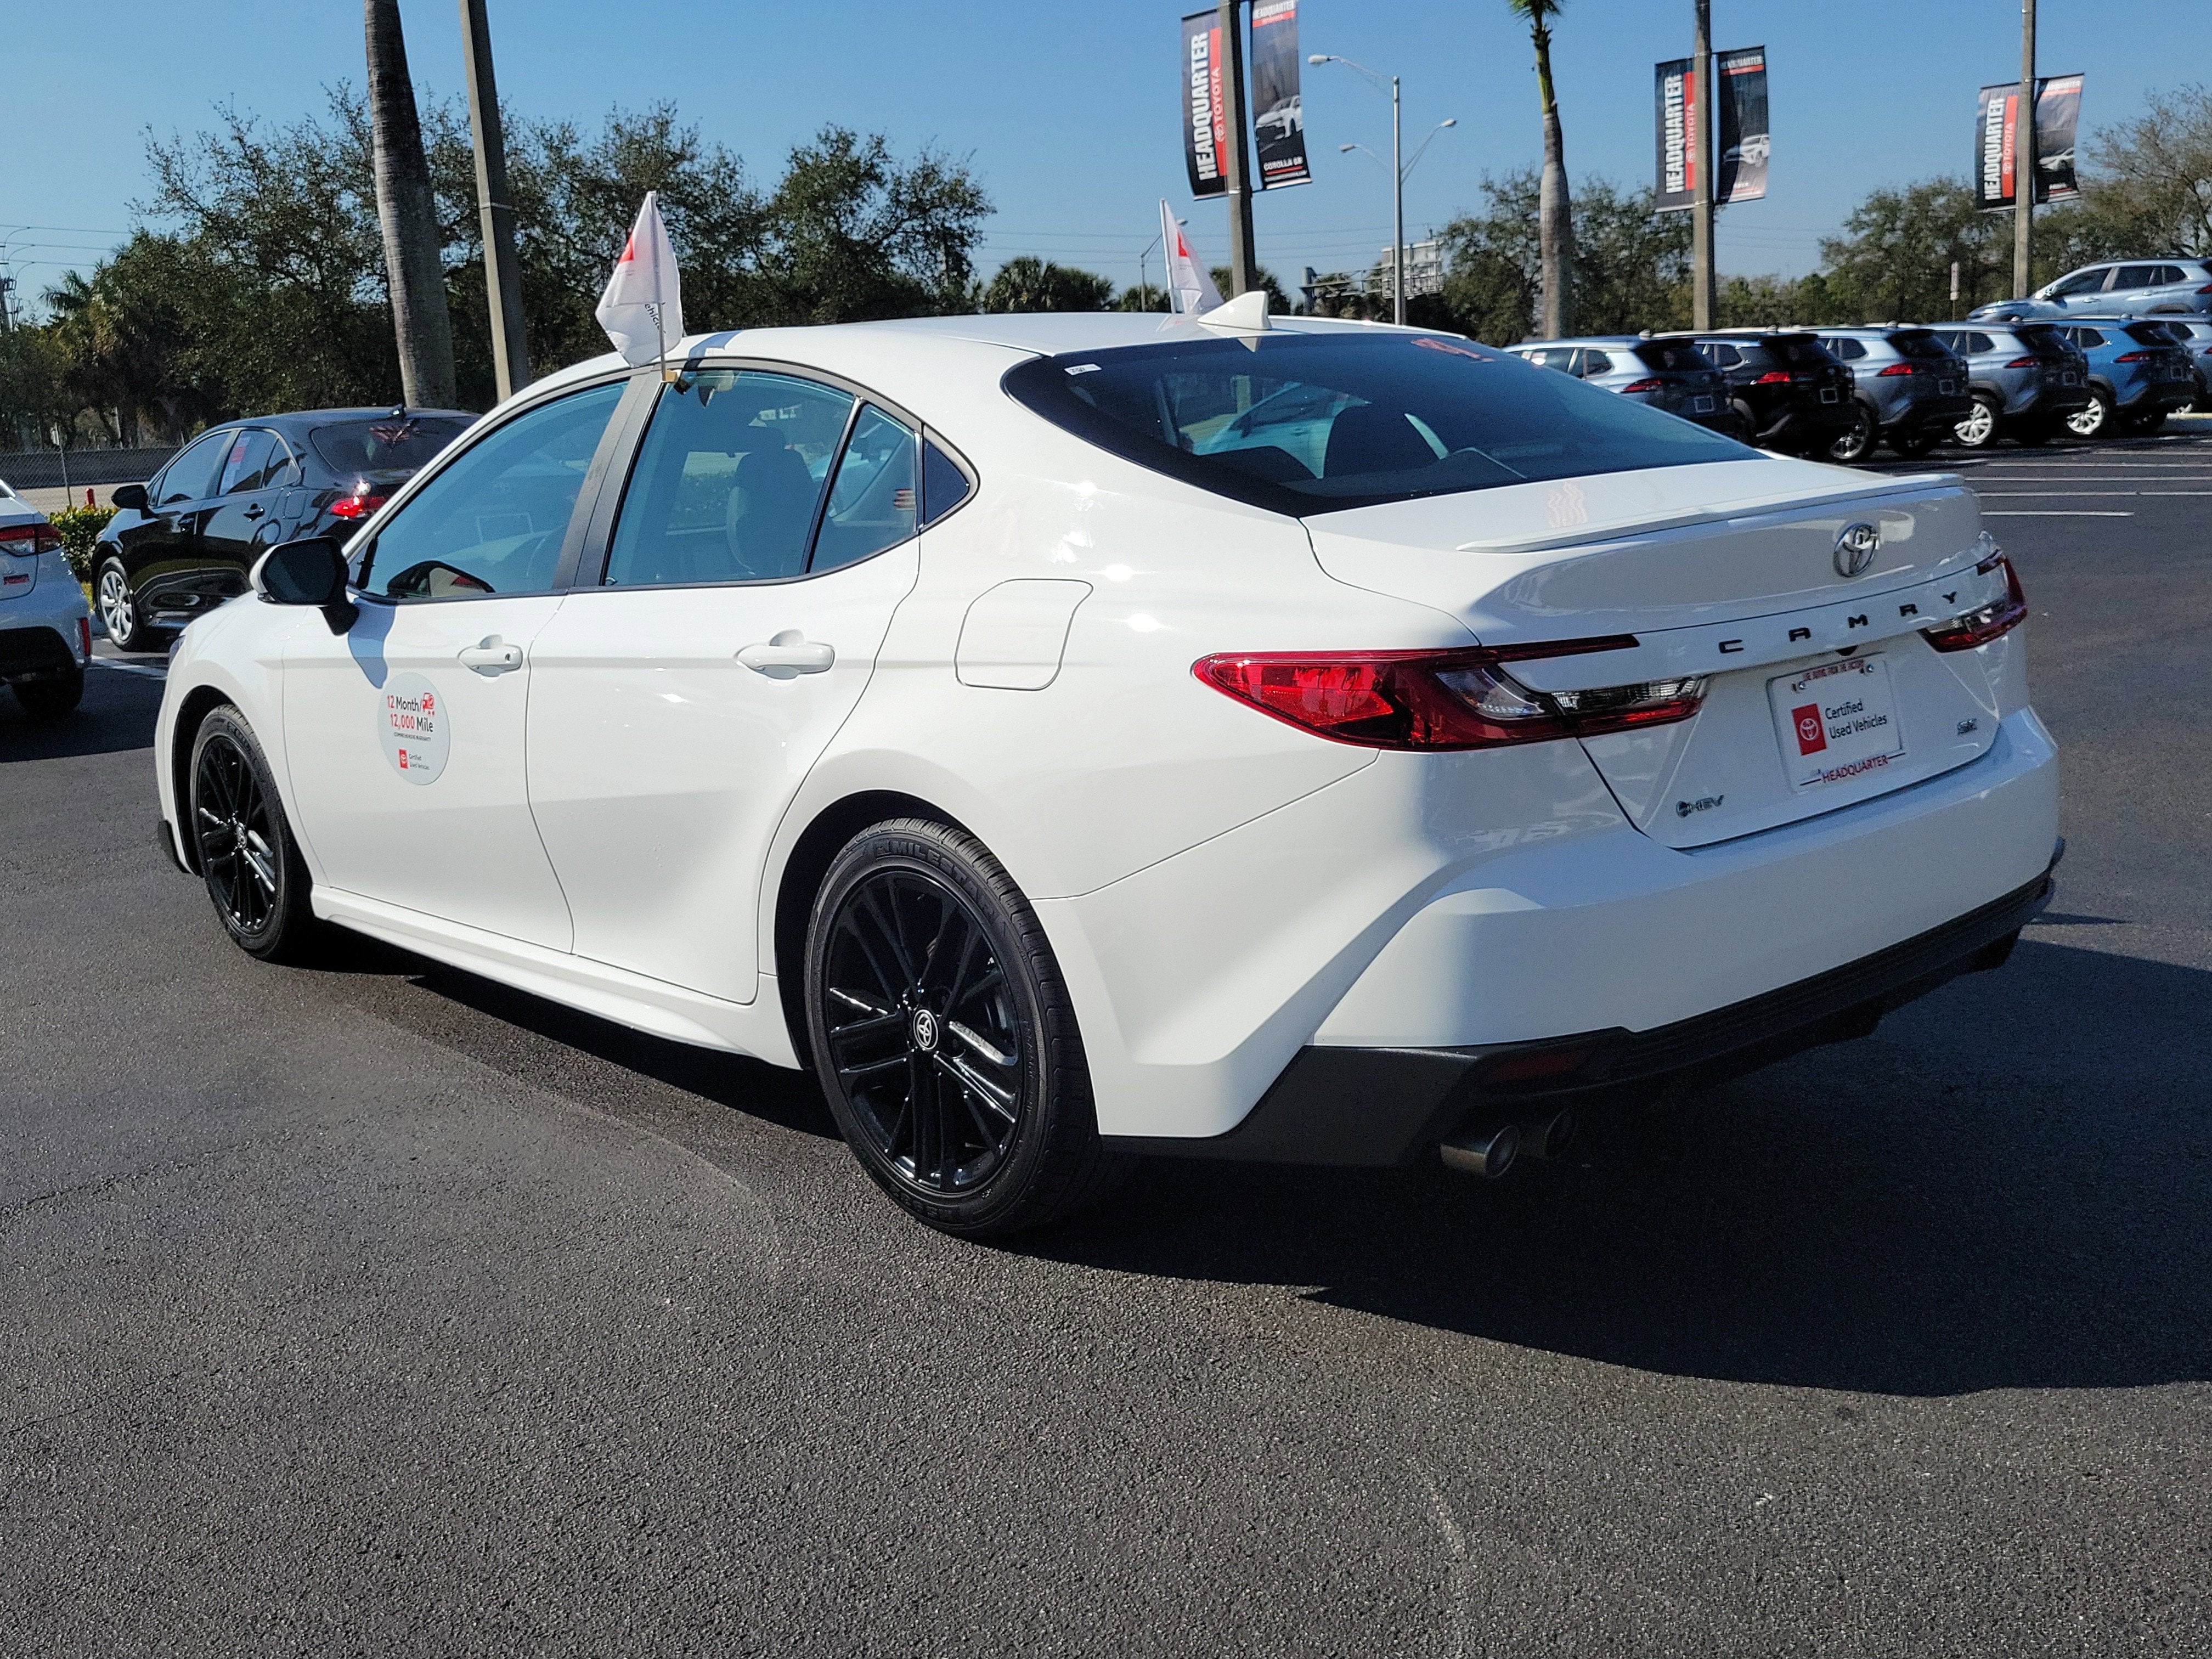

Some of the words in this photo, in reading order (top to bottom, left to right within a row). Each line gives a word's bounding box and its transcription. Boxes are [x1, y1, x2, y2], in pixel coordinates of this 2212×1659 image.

[1191, 32, 1217, 181] HEADQUARTER
[1210, 66, 1224, 126] TOYOTA
[1664, 74, 1684, 193] HEADQUARTER
[1984, 98, 2006, 200] HEADQUARTER
[1719, 591, 1957, 653] CAMRY
[387, 695, 394, 708] 12
[391, 714, 415, 730] 12,000
[417, 716, 433, 732] Mile
[1825, 698, 1864, 720] Certified
[1829, 722, 1852, 740] Used
[1852, 714, 1888, 732] Vehicles
[1822, 758, 1888, 783] HEADQUARTER
